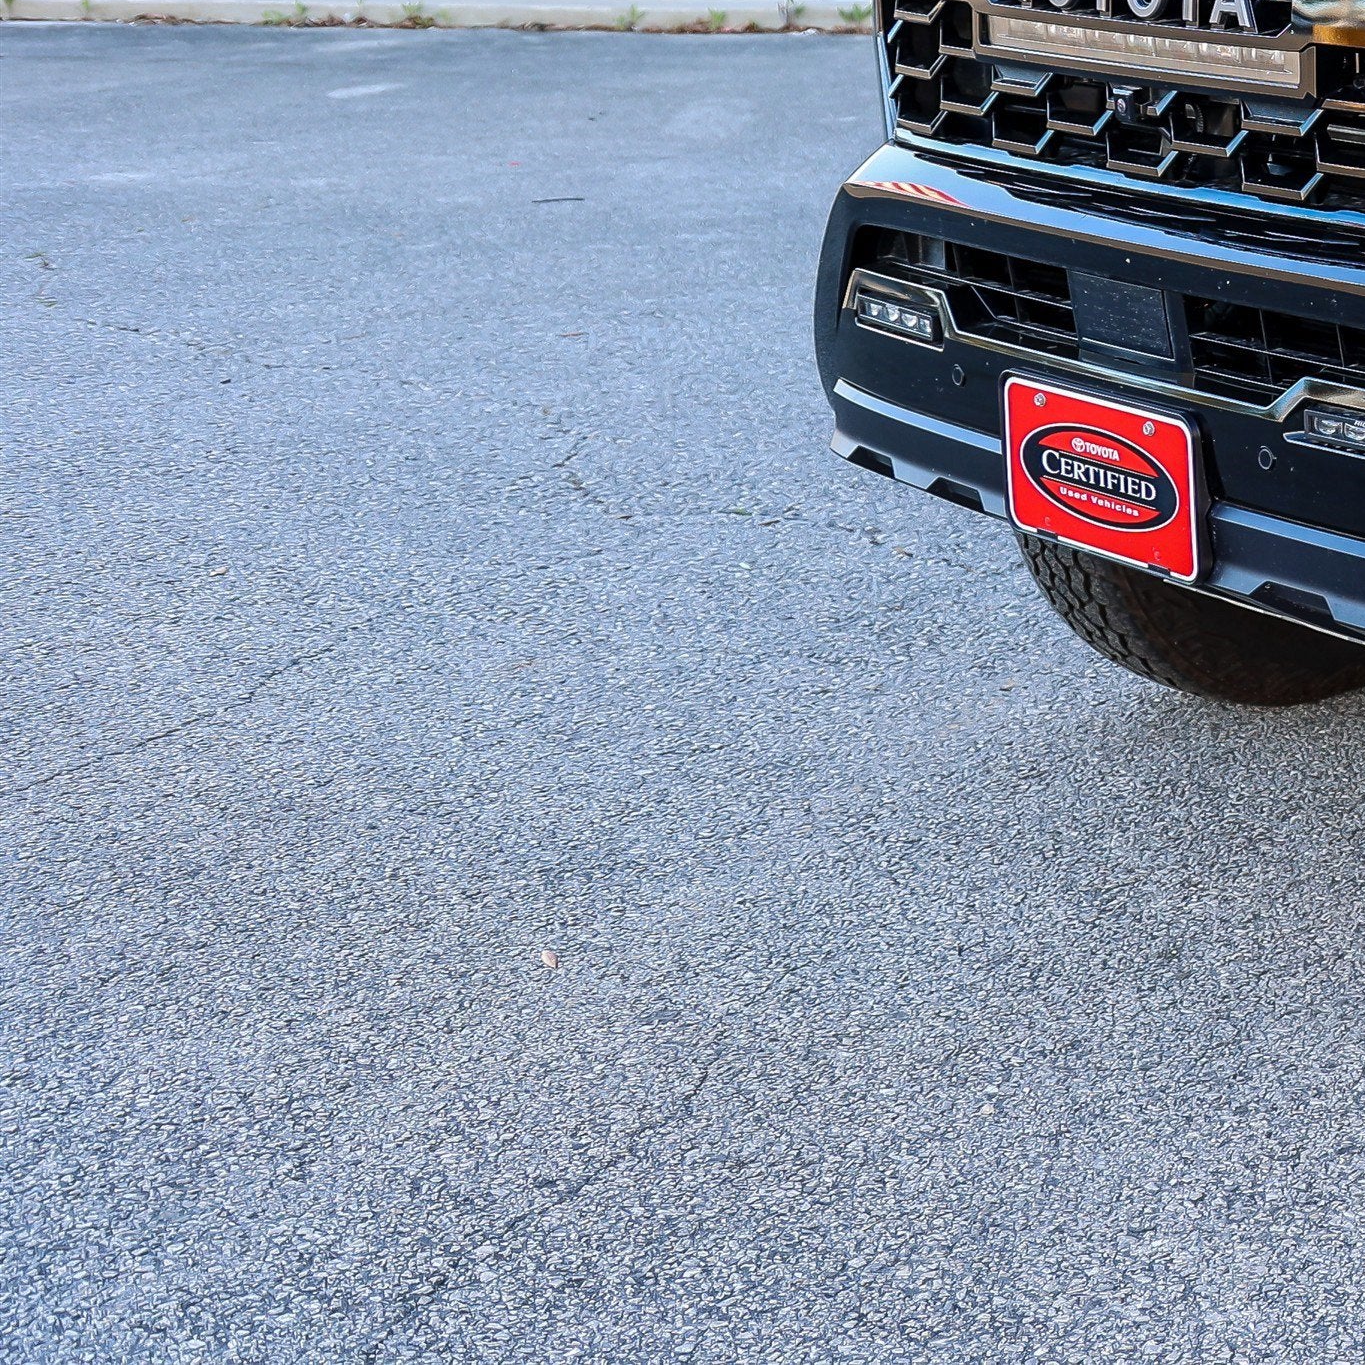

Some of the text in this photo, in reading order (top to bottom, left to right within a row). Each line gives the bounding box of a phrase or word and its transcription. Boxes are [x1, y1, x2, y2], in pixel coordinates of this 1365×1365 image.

[1085, 443, 1120, 462] TOYOTA
[1041, 448, 1157, 501] CERTIFIED
[1059, 486, 1140, 517] Used Vehicles
